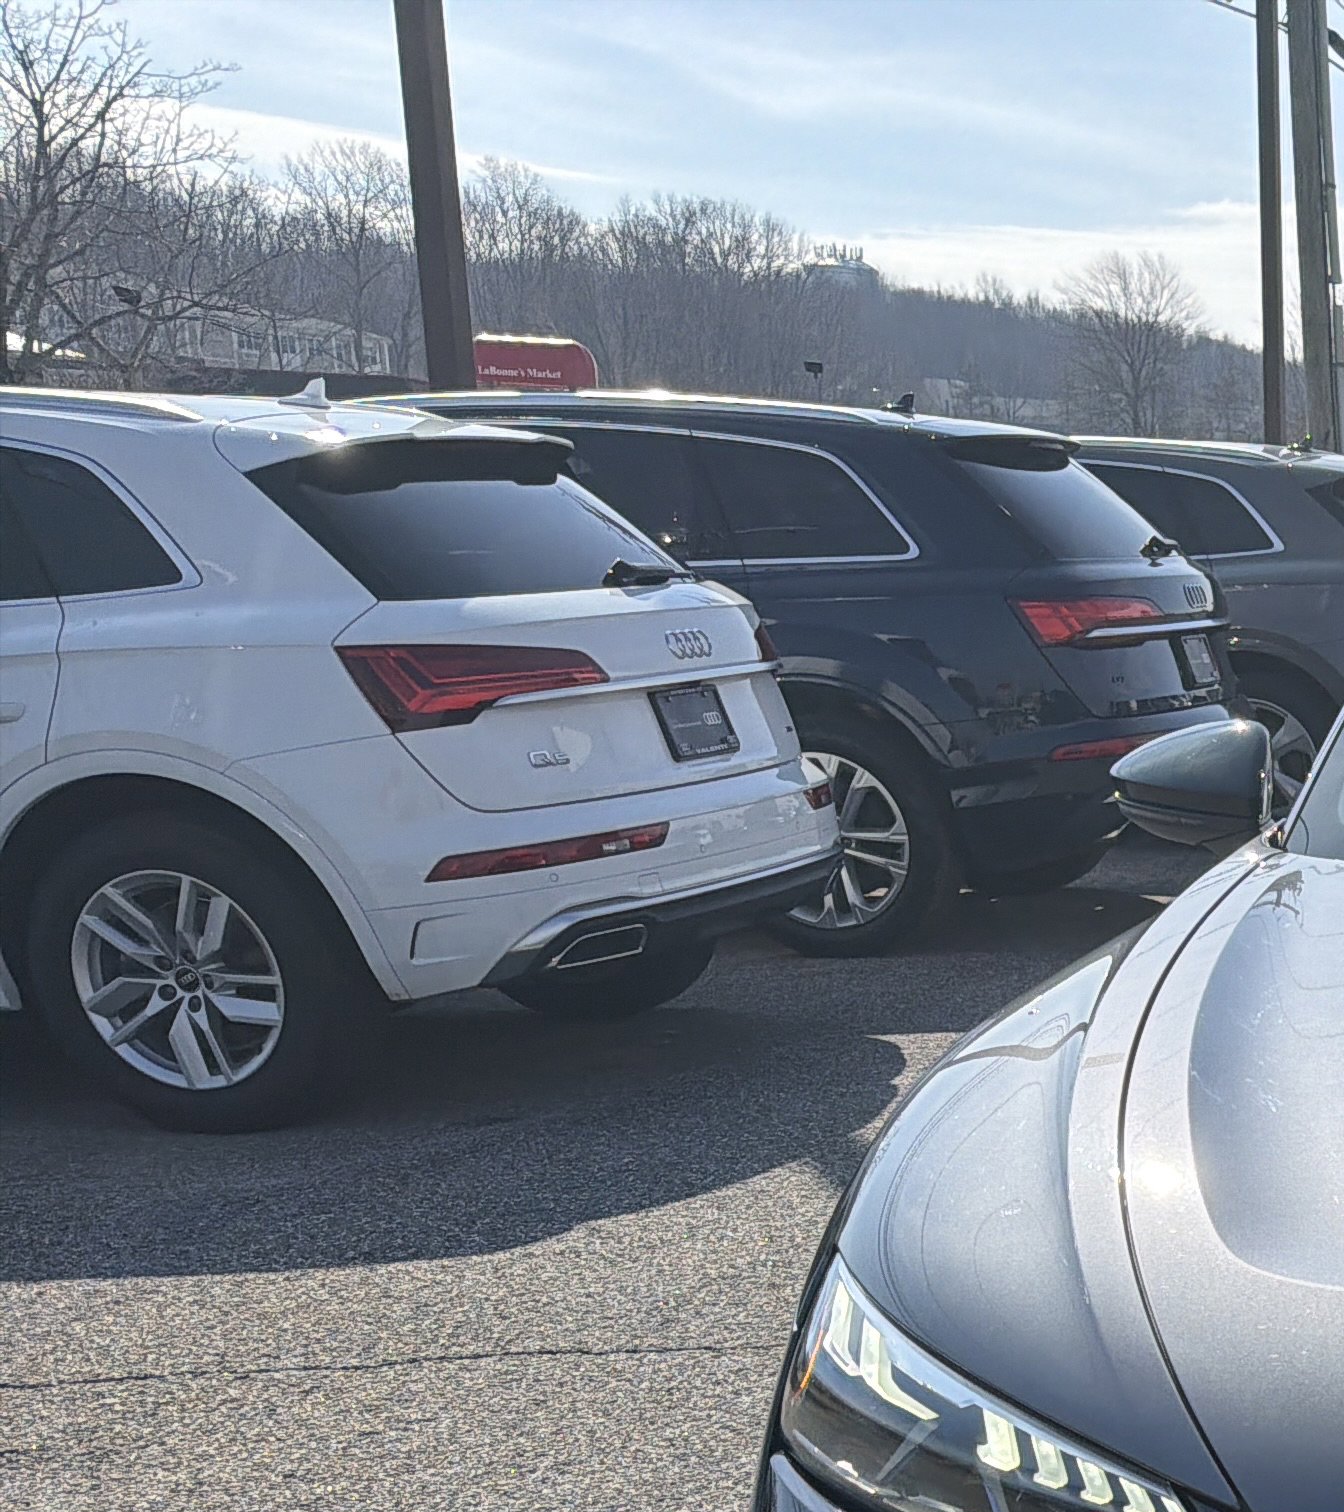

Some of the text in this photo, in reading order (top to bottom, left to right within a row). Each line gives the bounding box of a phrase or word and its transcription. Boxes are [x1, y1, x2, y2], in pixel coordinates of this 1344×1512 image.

[477, 364, 562, 379] LaBonne's Market
[527, 750, 571, 769] Q5
